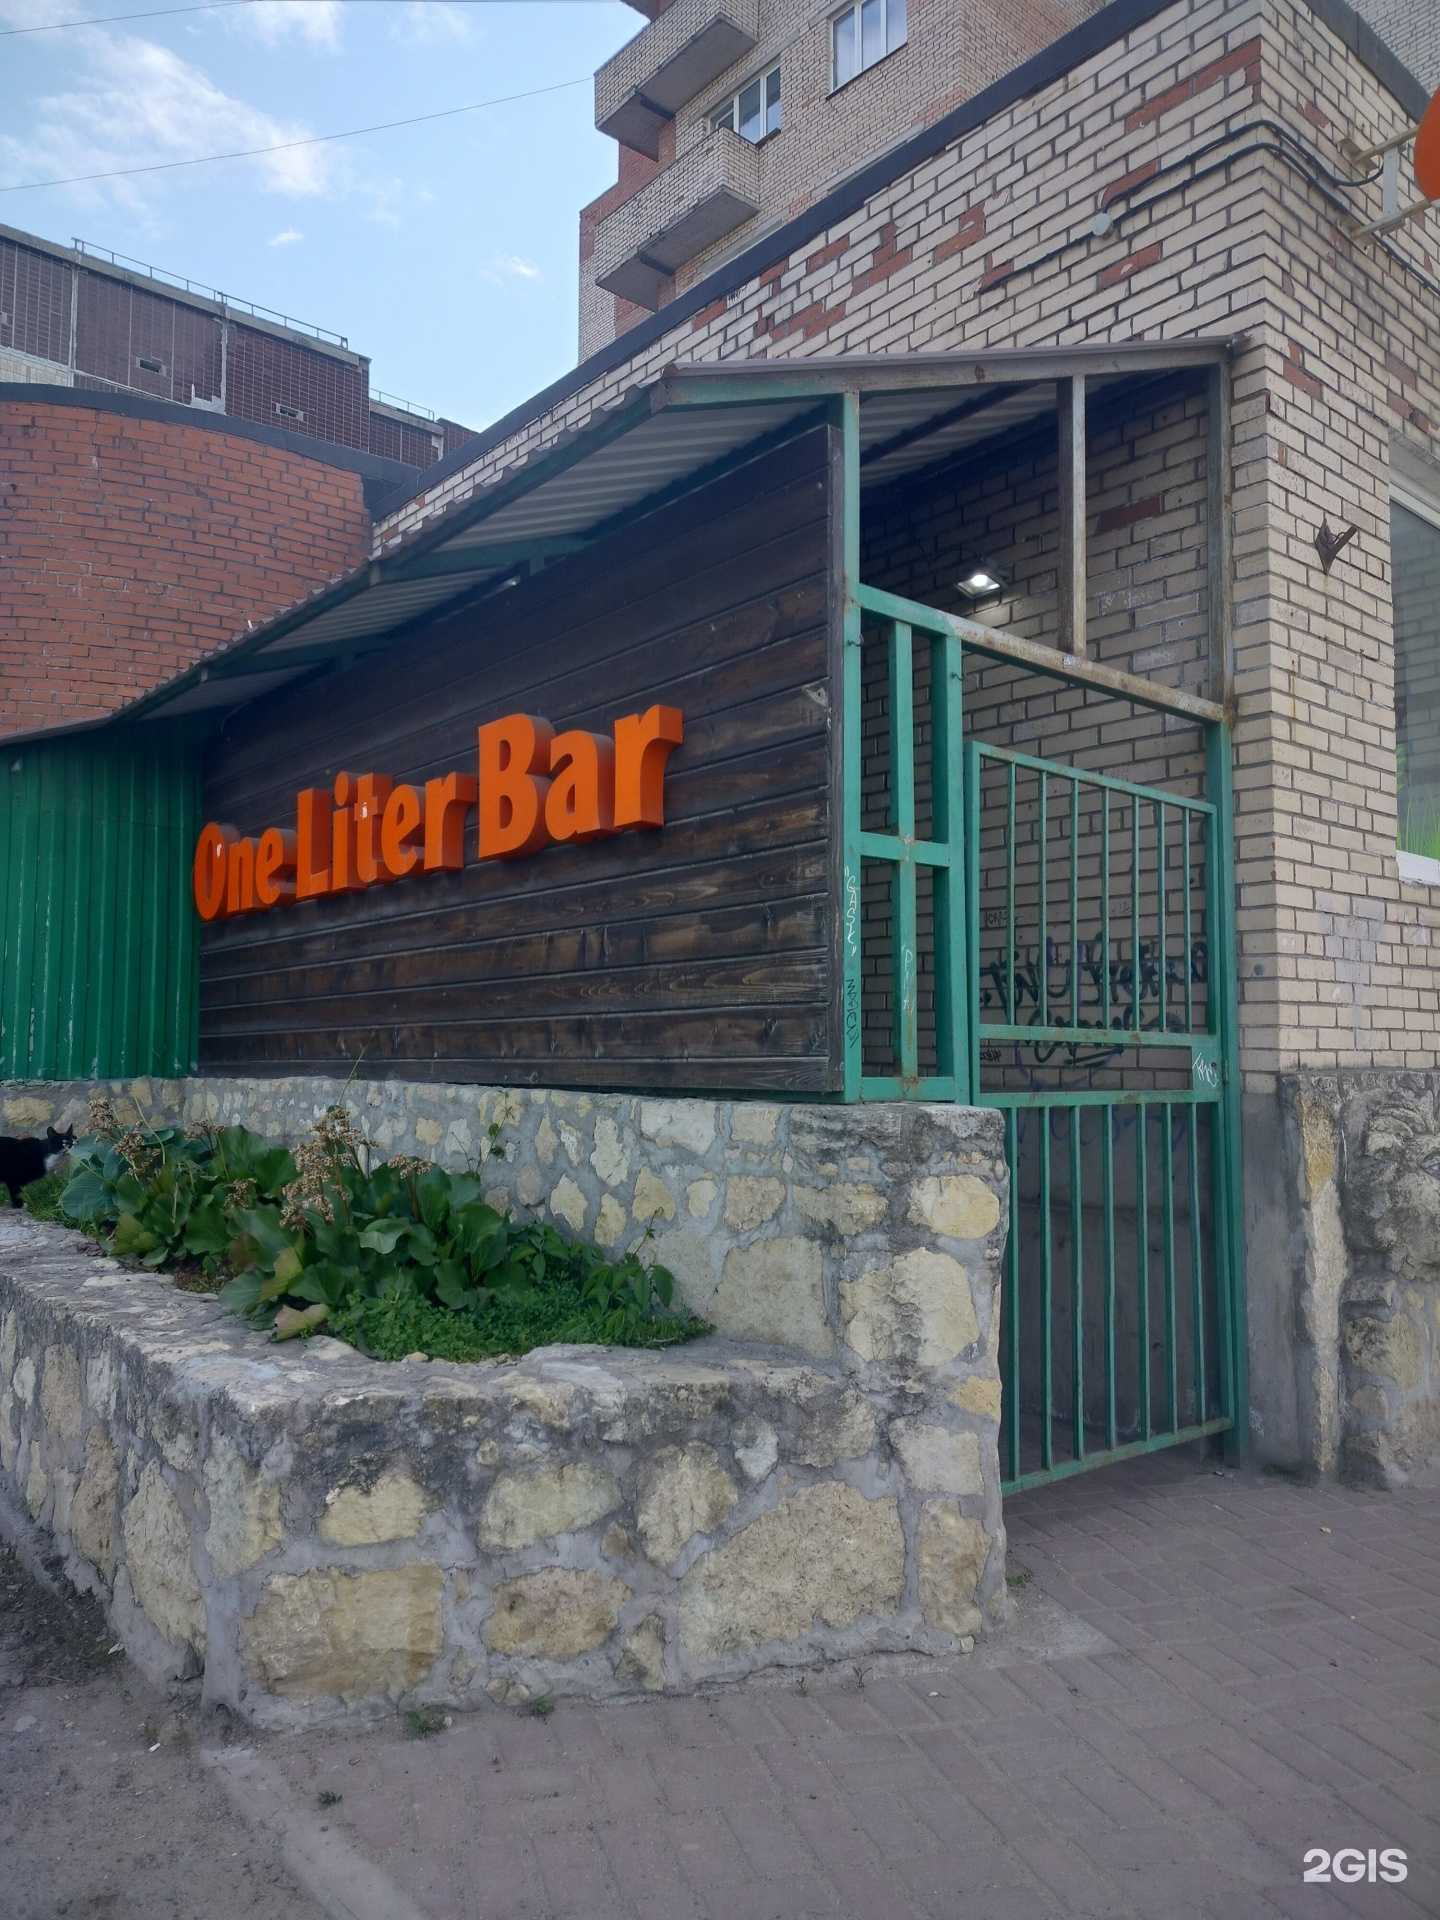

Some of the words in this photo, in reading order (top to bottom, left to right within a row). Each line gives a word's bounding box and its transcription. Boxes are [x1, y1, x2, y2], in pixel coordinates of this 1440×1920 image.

[194, 821, 297, 921] One
[296, 770, 477, 900] Liter
[478, 704, 684, 860] Bar
